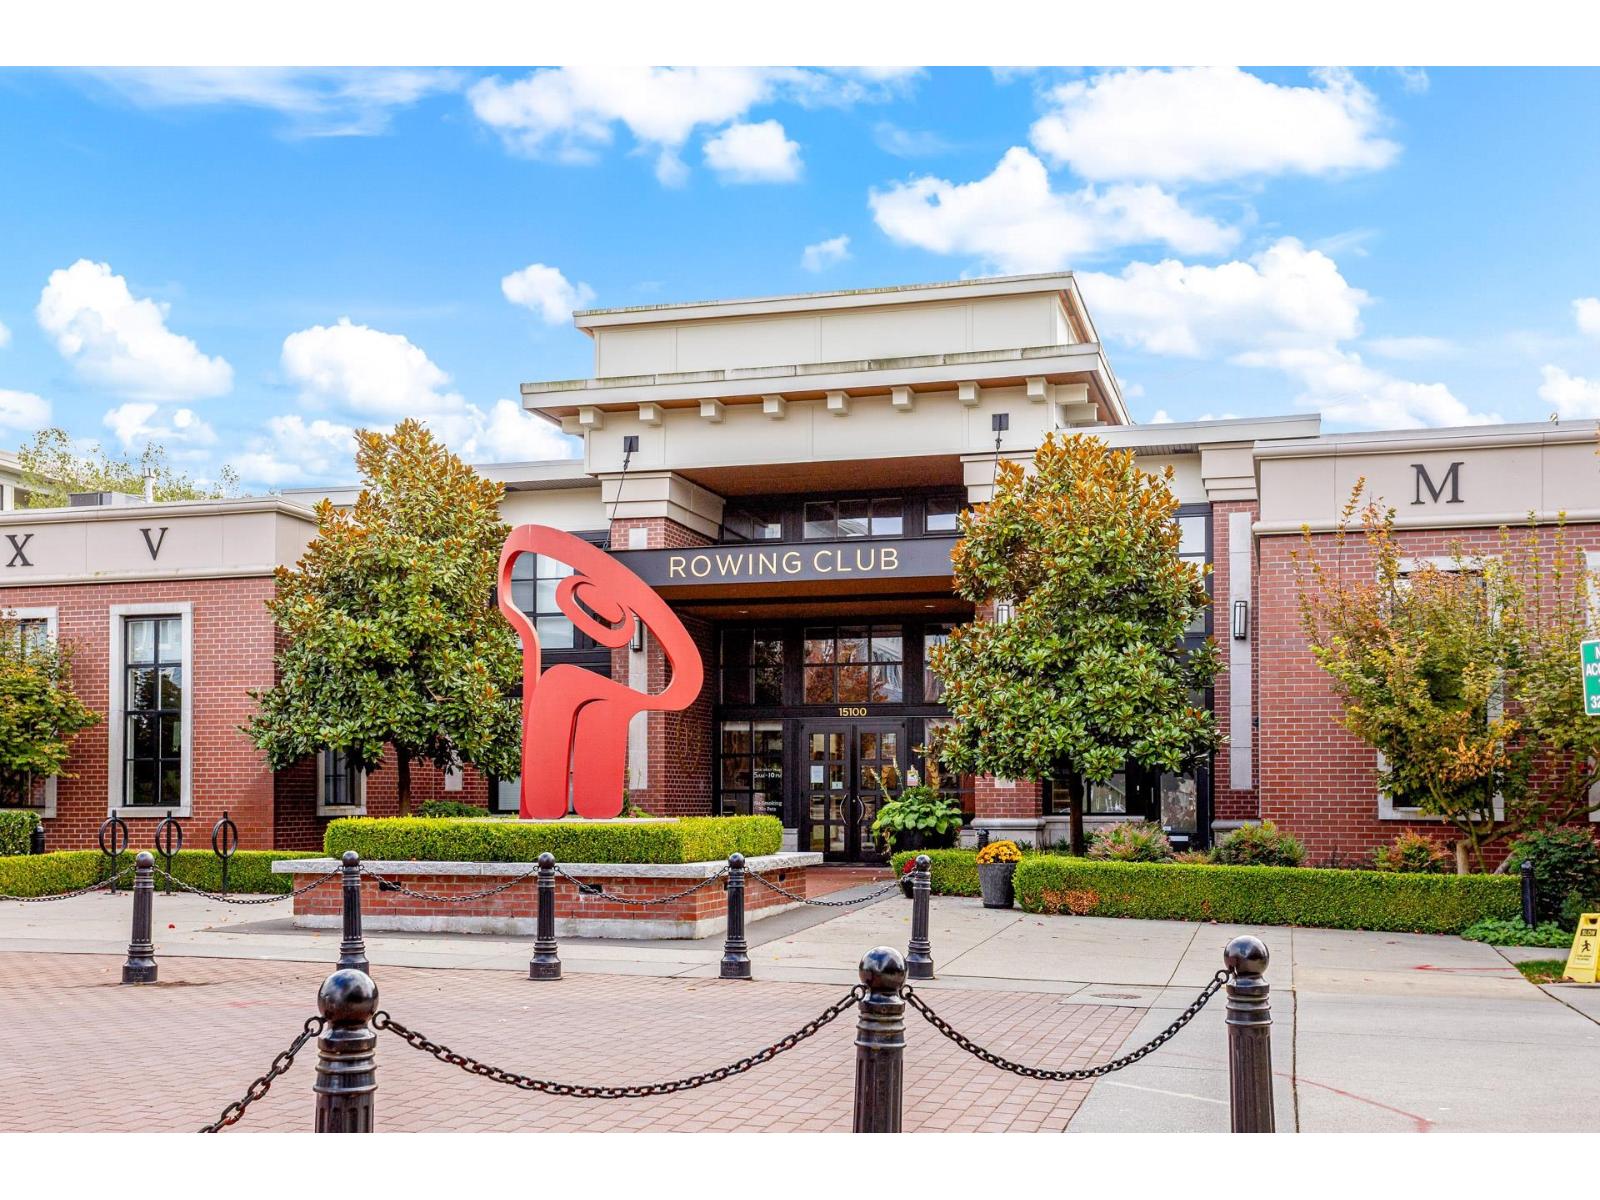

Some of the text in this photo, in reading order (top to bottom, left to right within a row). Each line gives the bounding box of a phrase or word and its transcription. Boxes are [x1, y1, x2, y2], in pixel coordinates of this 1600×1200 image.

[1410, 461, 1464, 505] M
[5, 533, 34, 567] X
[139, 527, 168, 561] V
[669, 548, 899, 578] ROWING CLUB
[838, 707, 867, 717] 15100
